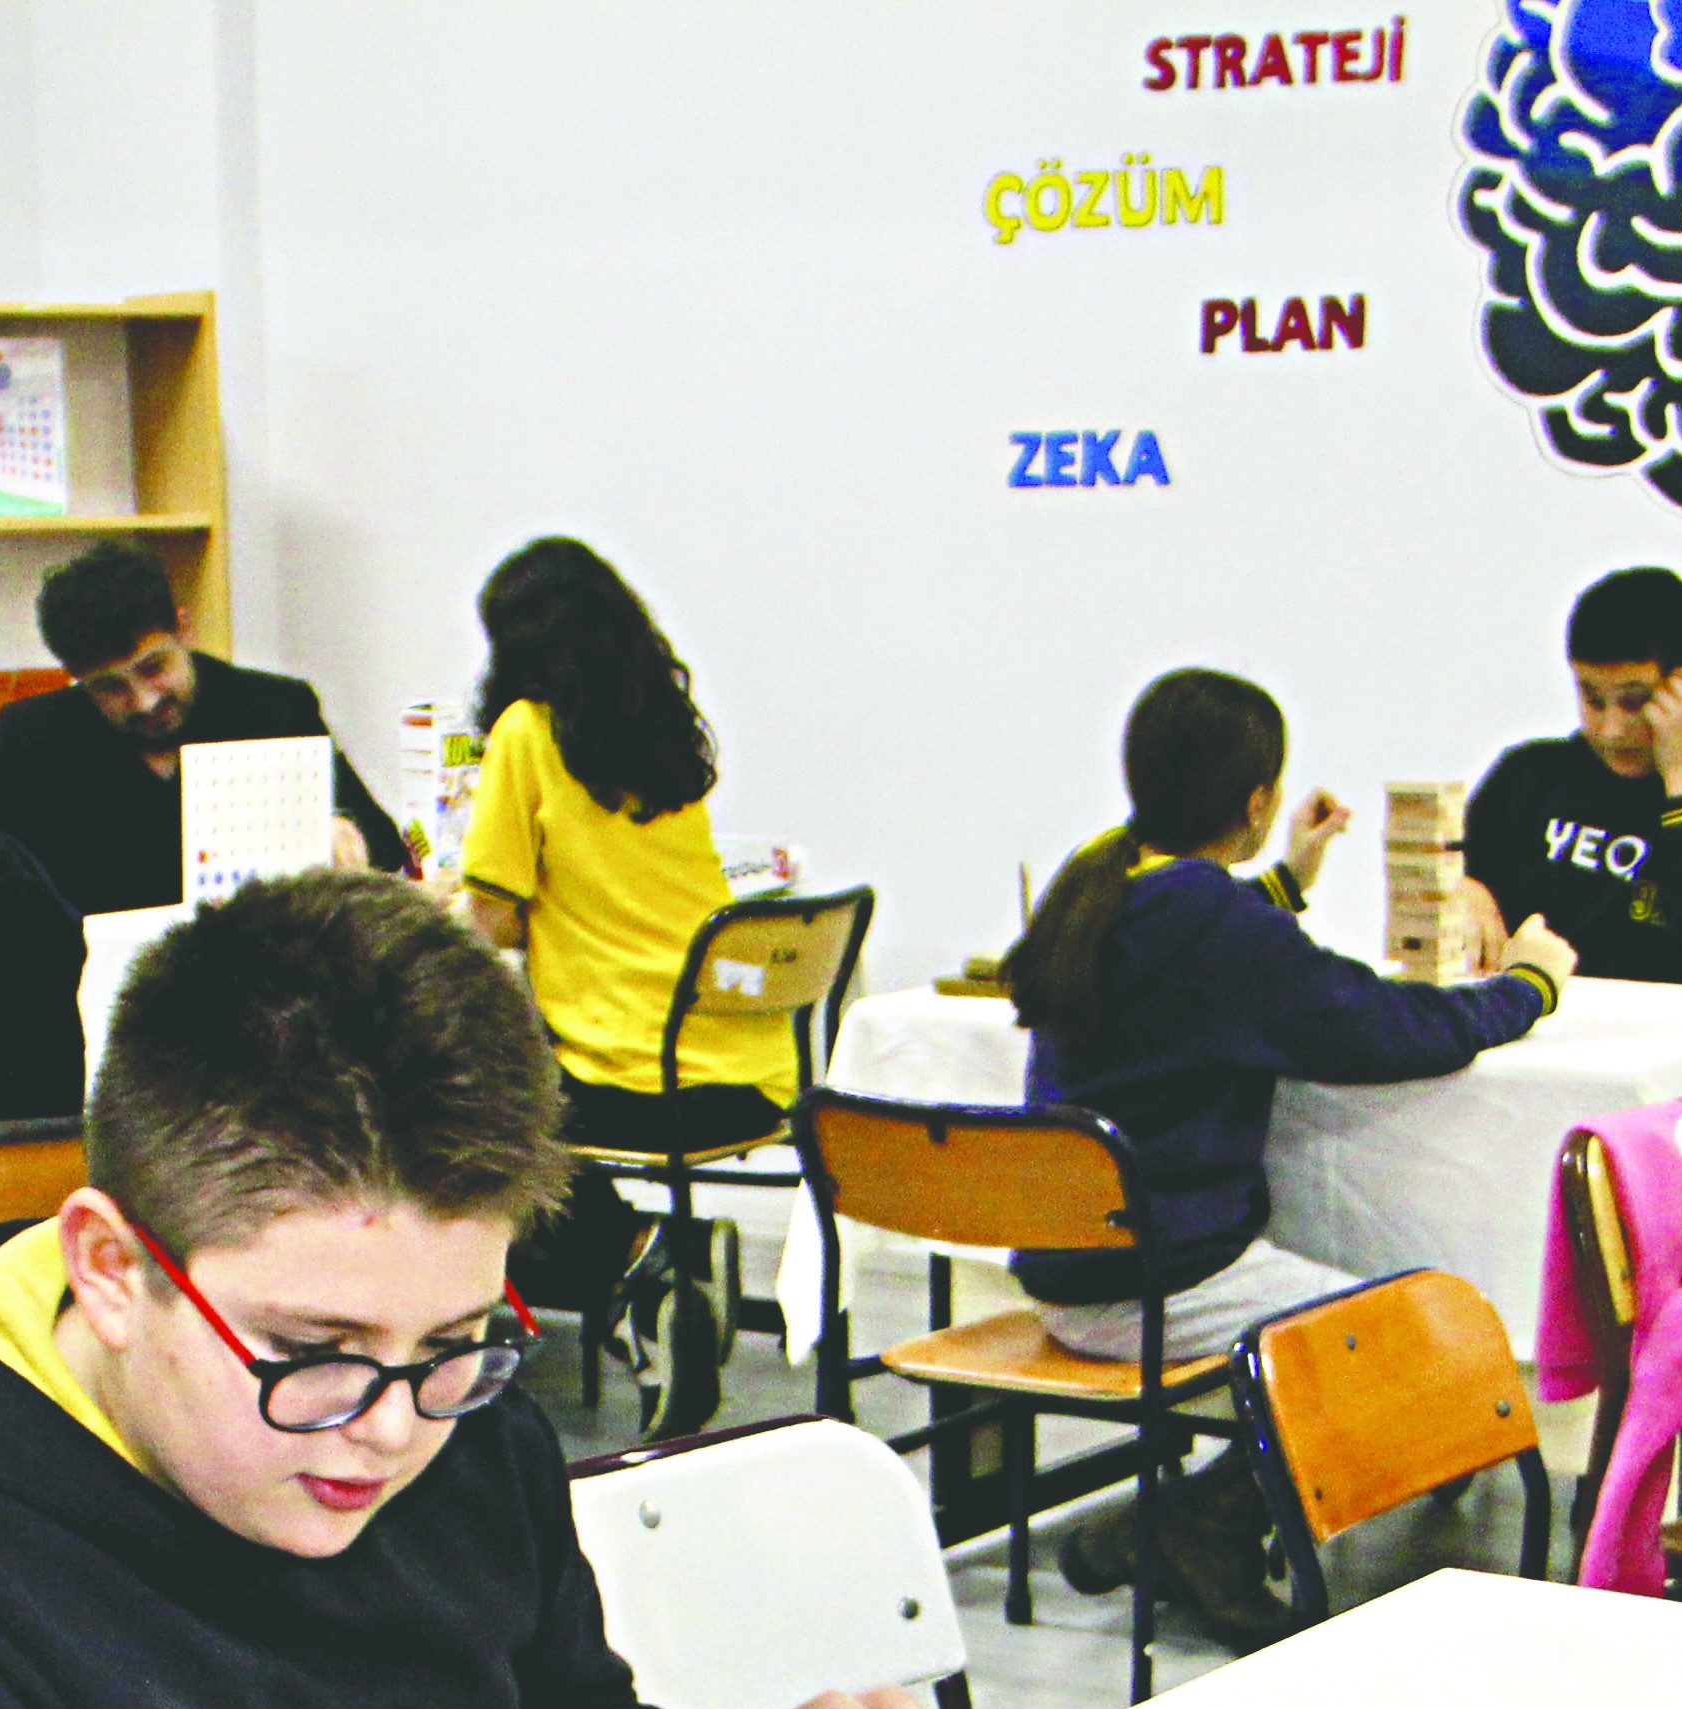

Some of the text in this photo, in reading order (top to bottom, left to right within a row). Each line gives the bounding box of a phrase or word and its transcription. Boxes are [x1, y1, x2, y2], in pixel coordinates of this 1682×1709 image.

[1143, 15, 1409, 92] STRATEJİ
[984, 152, 1226, 246] ÇÖZÜM
[1200, 293, 1368, 356] PLAN
[1008, 429, 1172, 488] ZEKA
[1544, 817, 1651, 882] YEO
